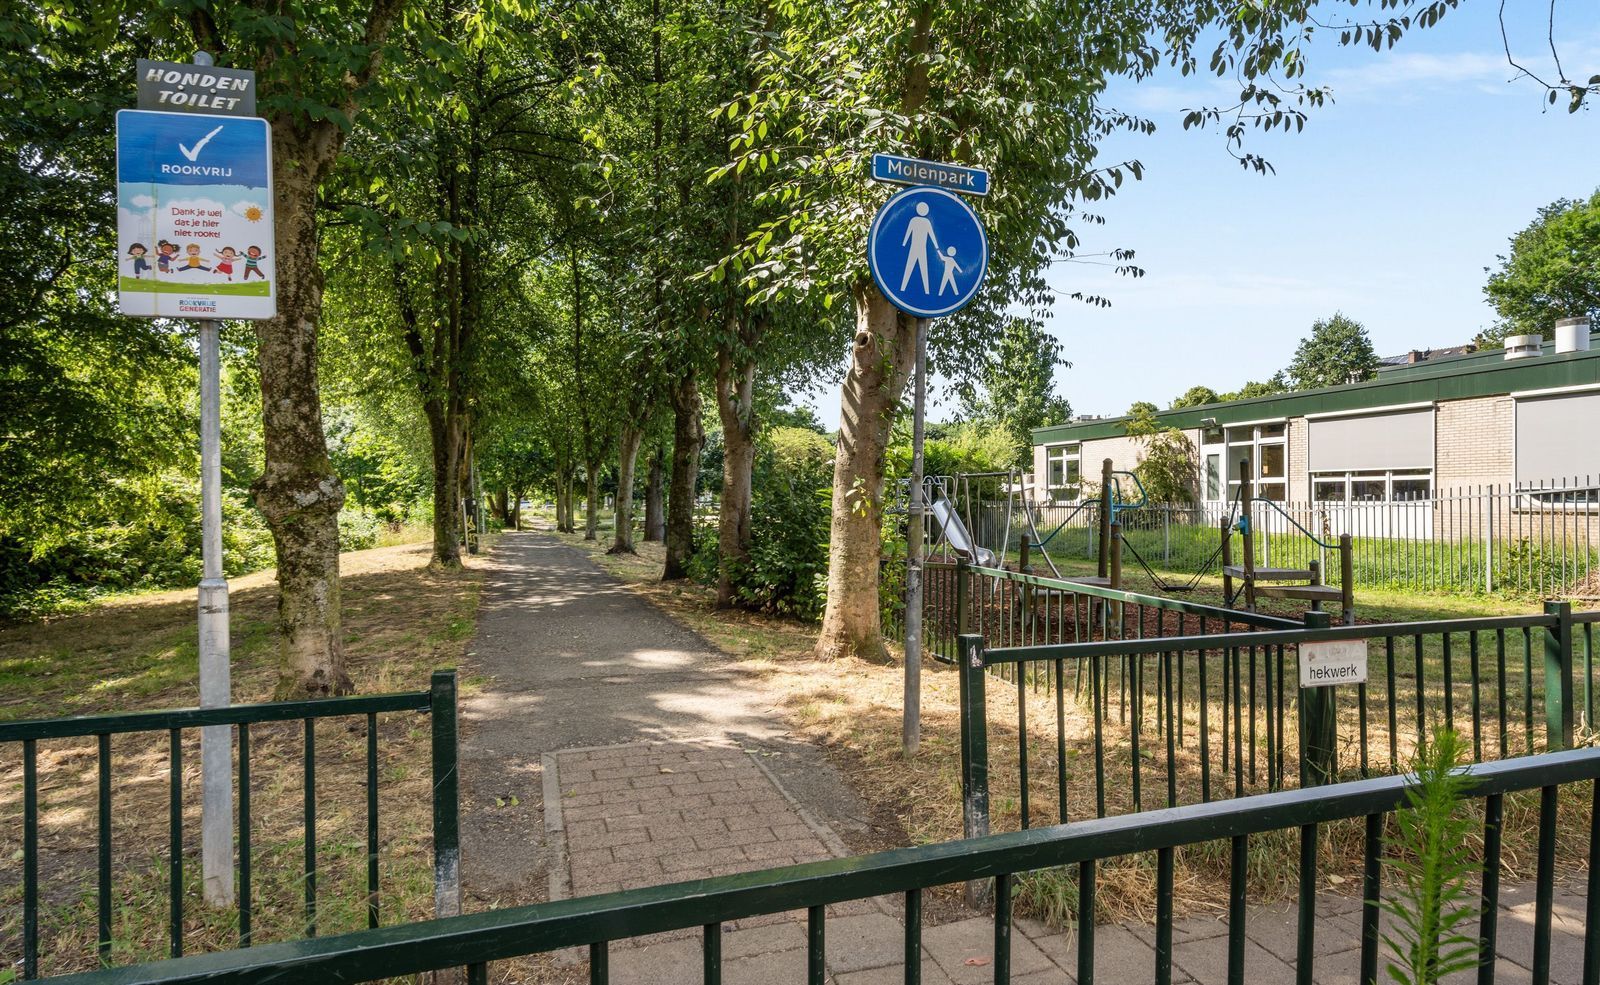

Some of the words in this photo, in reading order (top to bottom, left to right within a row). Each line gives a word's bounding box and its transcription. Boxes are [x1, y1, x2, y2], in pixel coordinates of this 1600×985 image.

[145, 69, 250, 91] HONDEN
[158, 90, 241, 111] TOILET
[161, 164, 232, 177] ROOKVRIJ
[887, 159, 975, 187] Molenpark
[172, 207, 195, 215] Dank
[196, 208, 206, 217] je
[207, 209, 222, 218] wel
[174, 219, 190, 227] dat
[191, 219, 200, 228] je
[202, 220, 220, 228] hier
[174, 229, 192, 237] niet
[194, 230, 220, 238] rookt!
[1309, 663, 1358, 679] hekwerk
